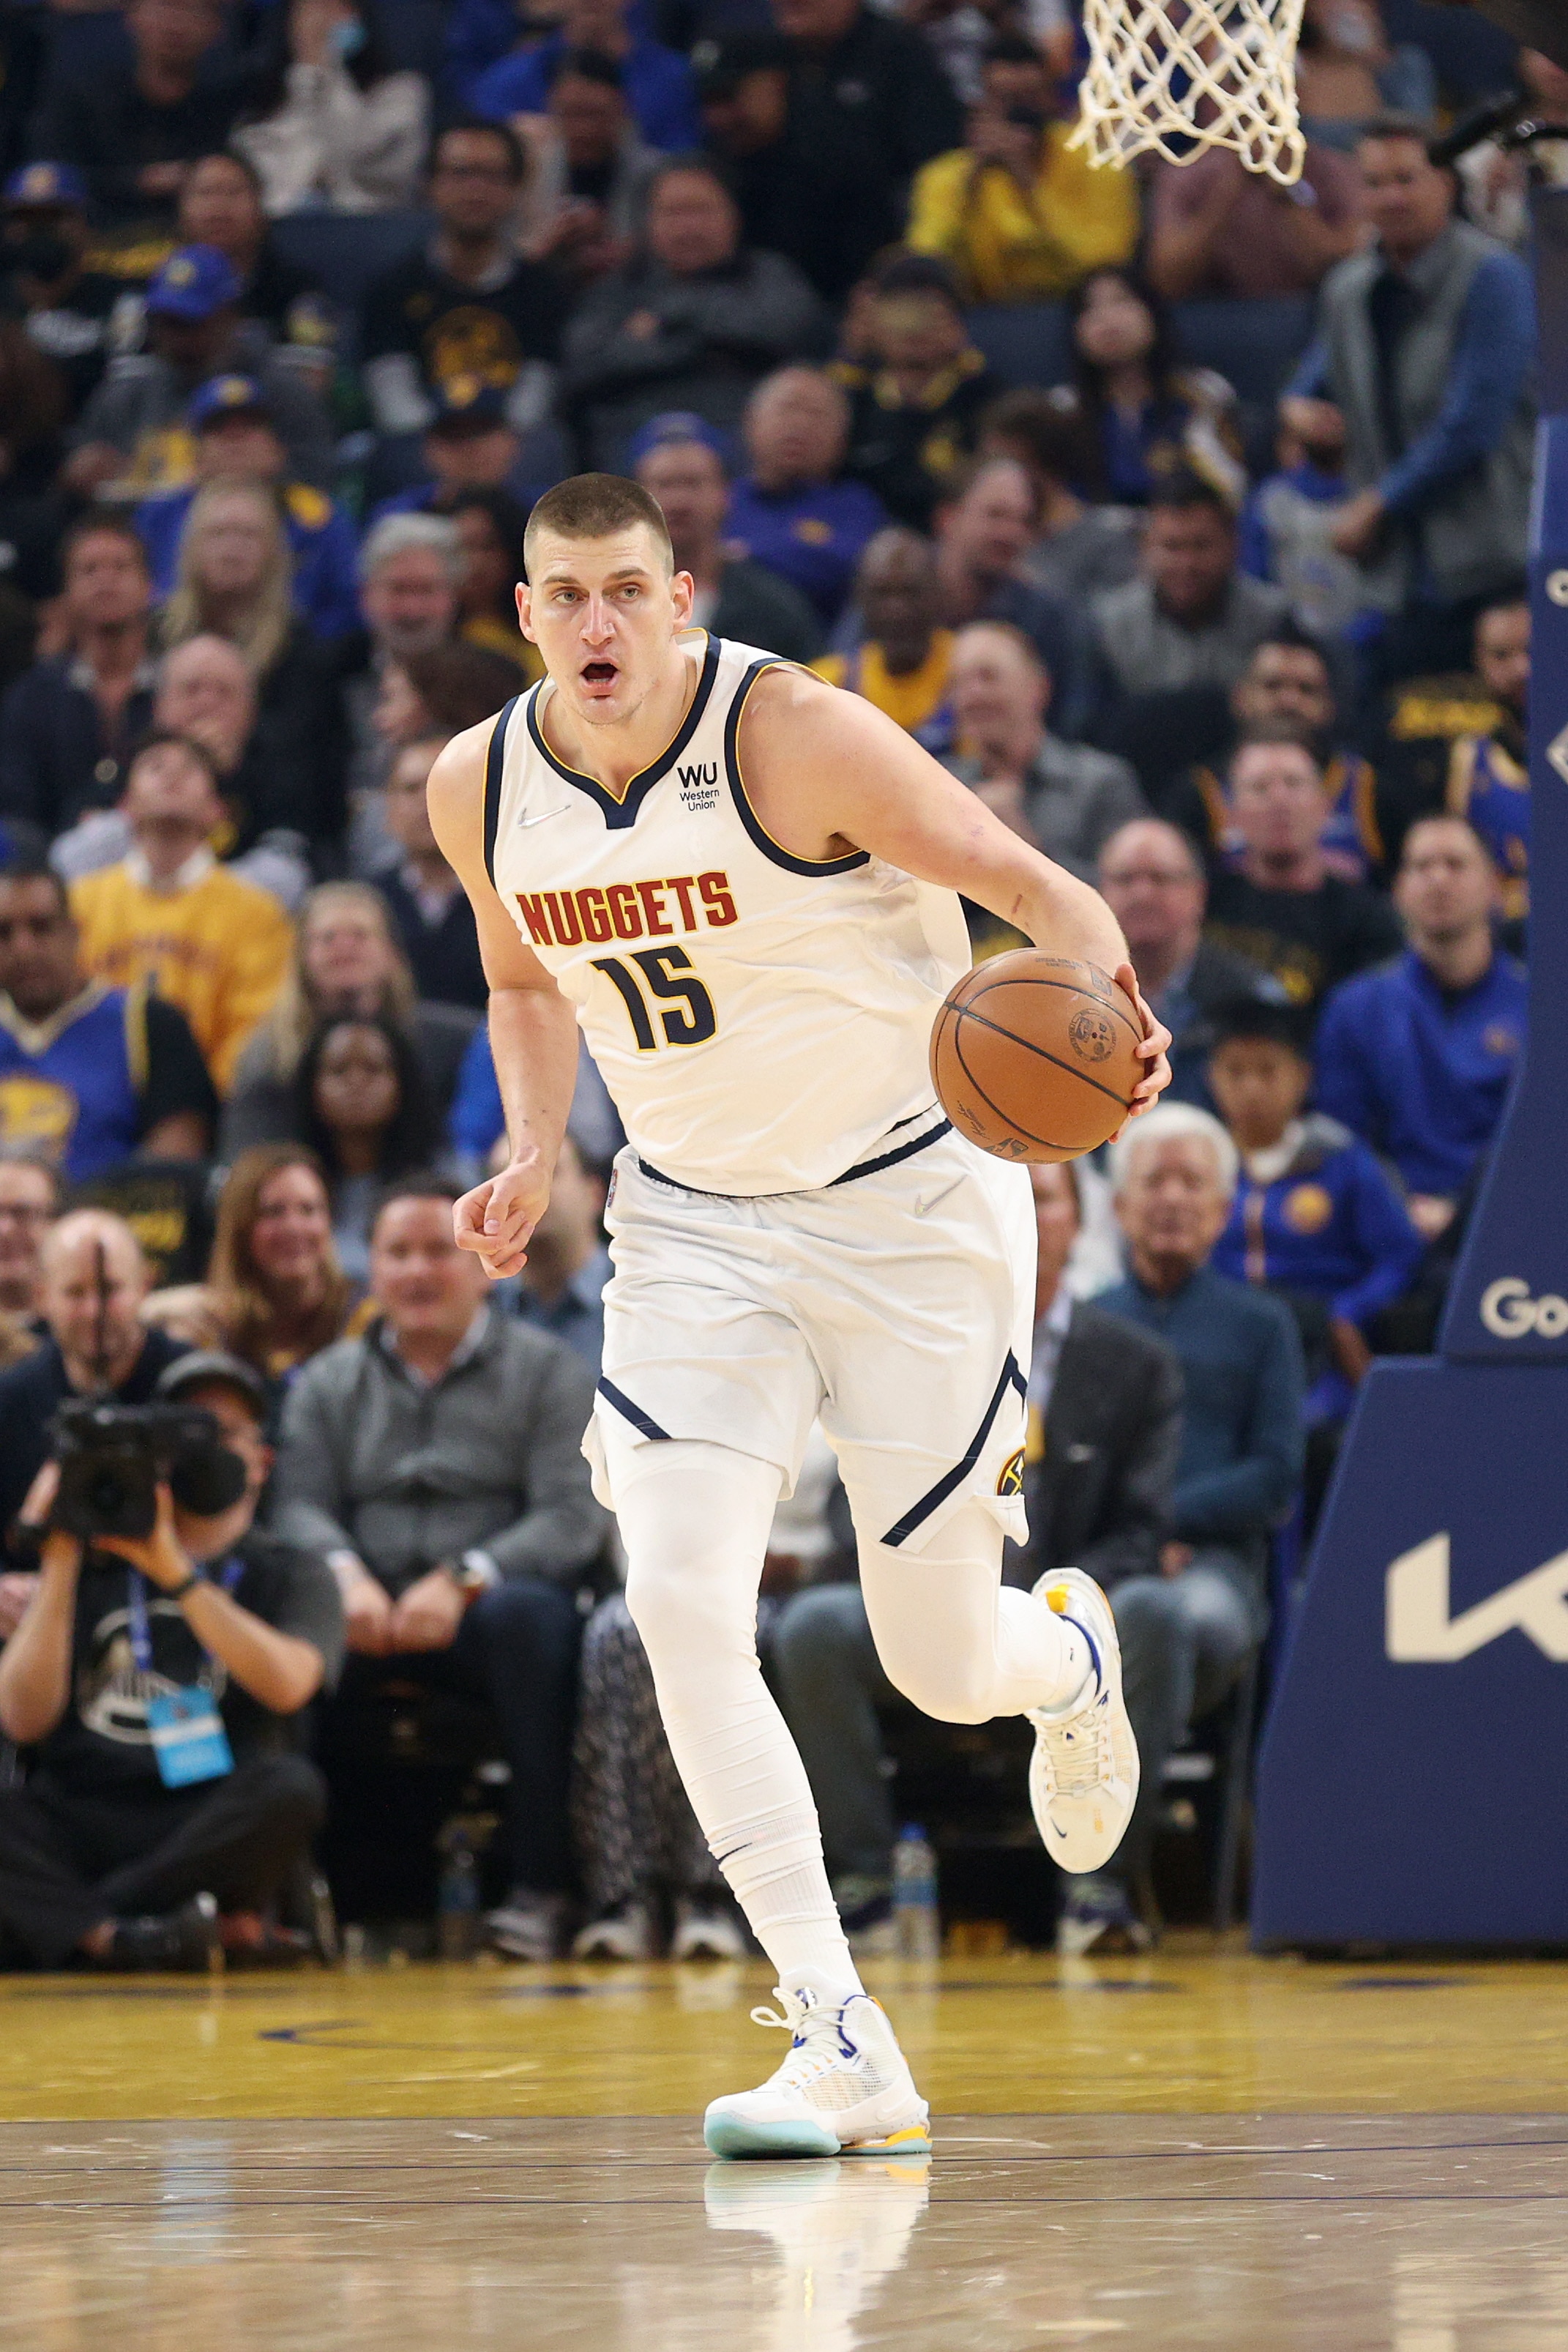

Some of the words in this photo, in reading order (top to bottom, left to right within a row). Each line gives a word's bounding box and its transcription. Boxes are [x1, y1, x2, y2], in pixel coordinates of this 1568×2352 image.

[677, 762, 717, 789] WU
[679, 789, 720, 802] Western
[687, 800, 715, 811] Union
[515, 871, 739, 946] NUGGETS
[588, 944, 718, 1052] 15
